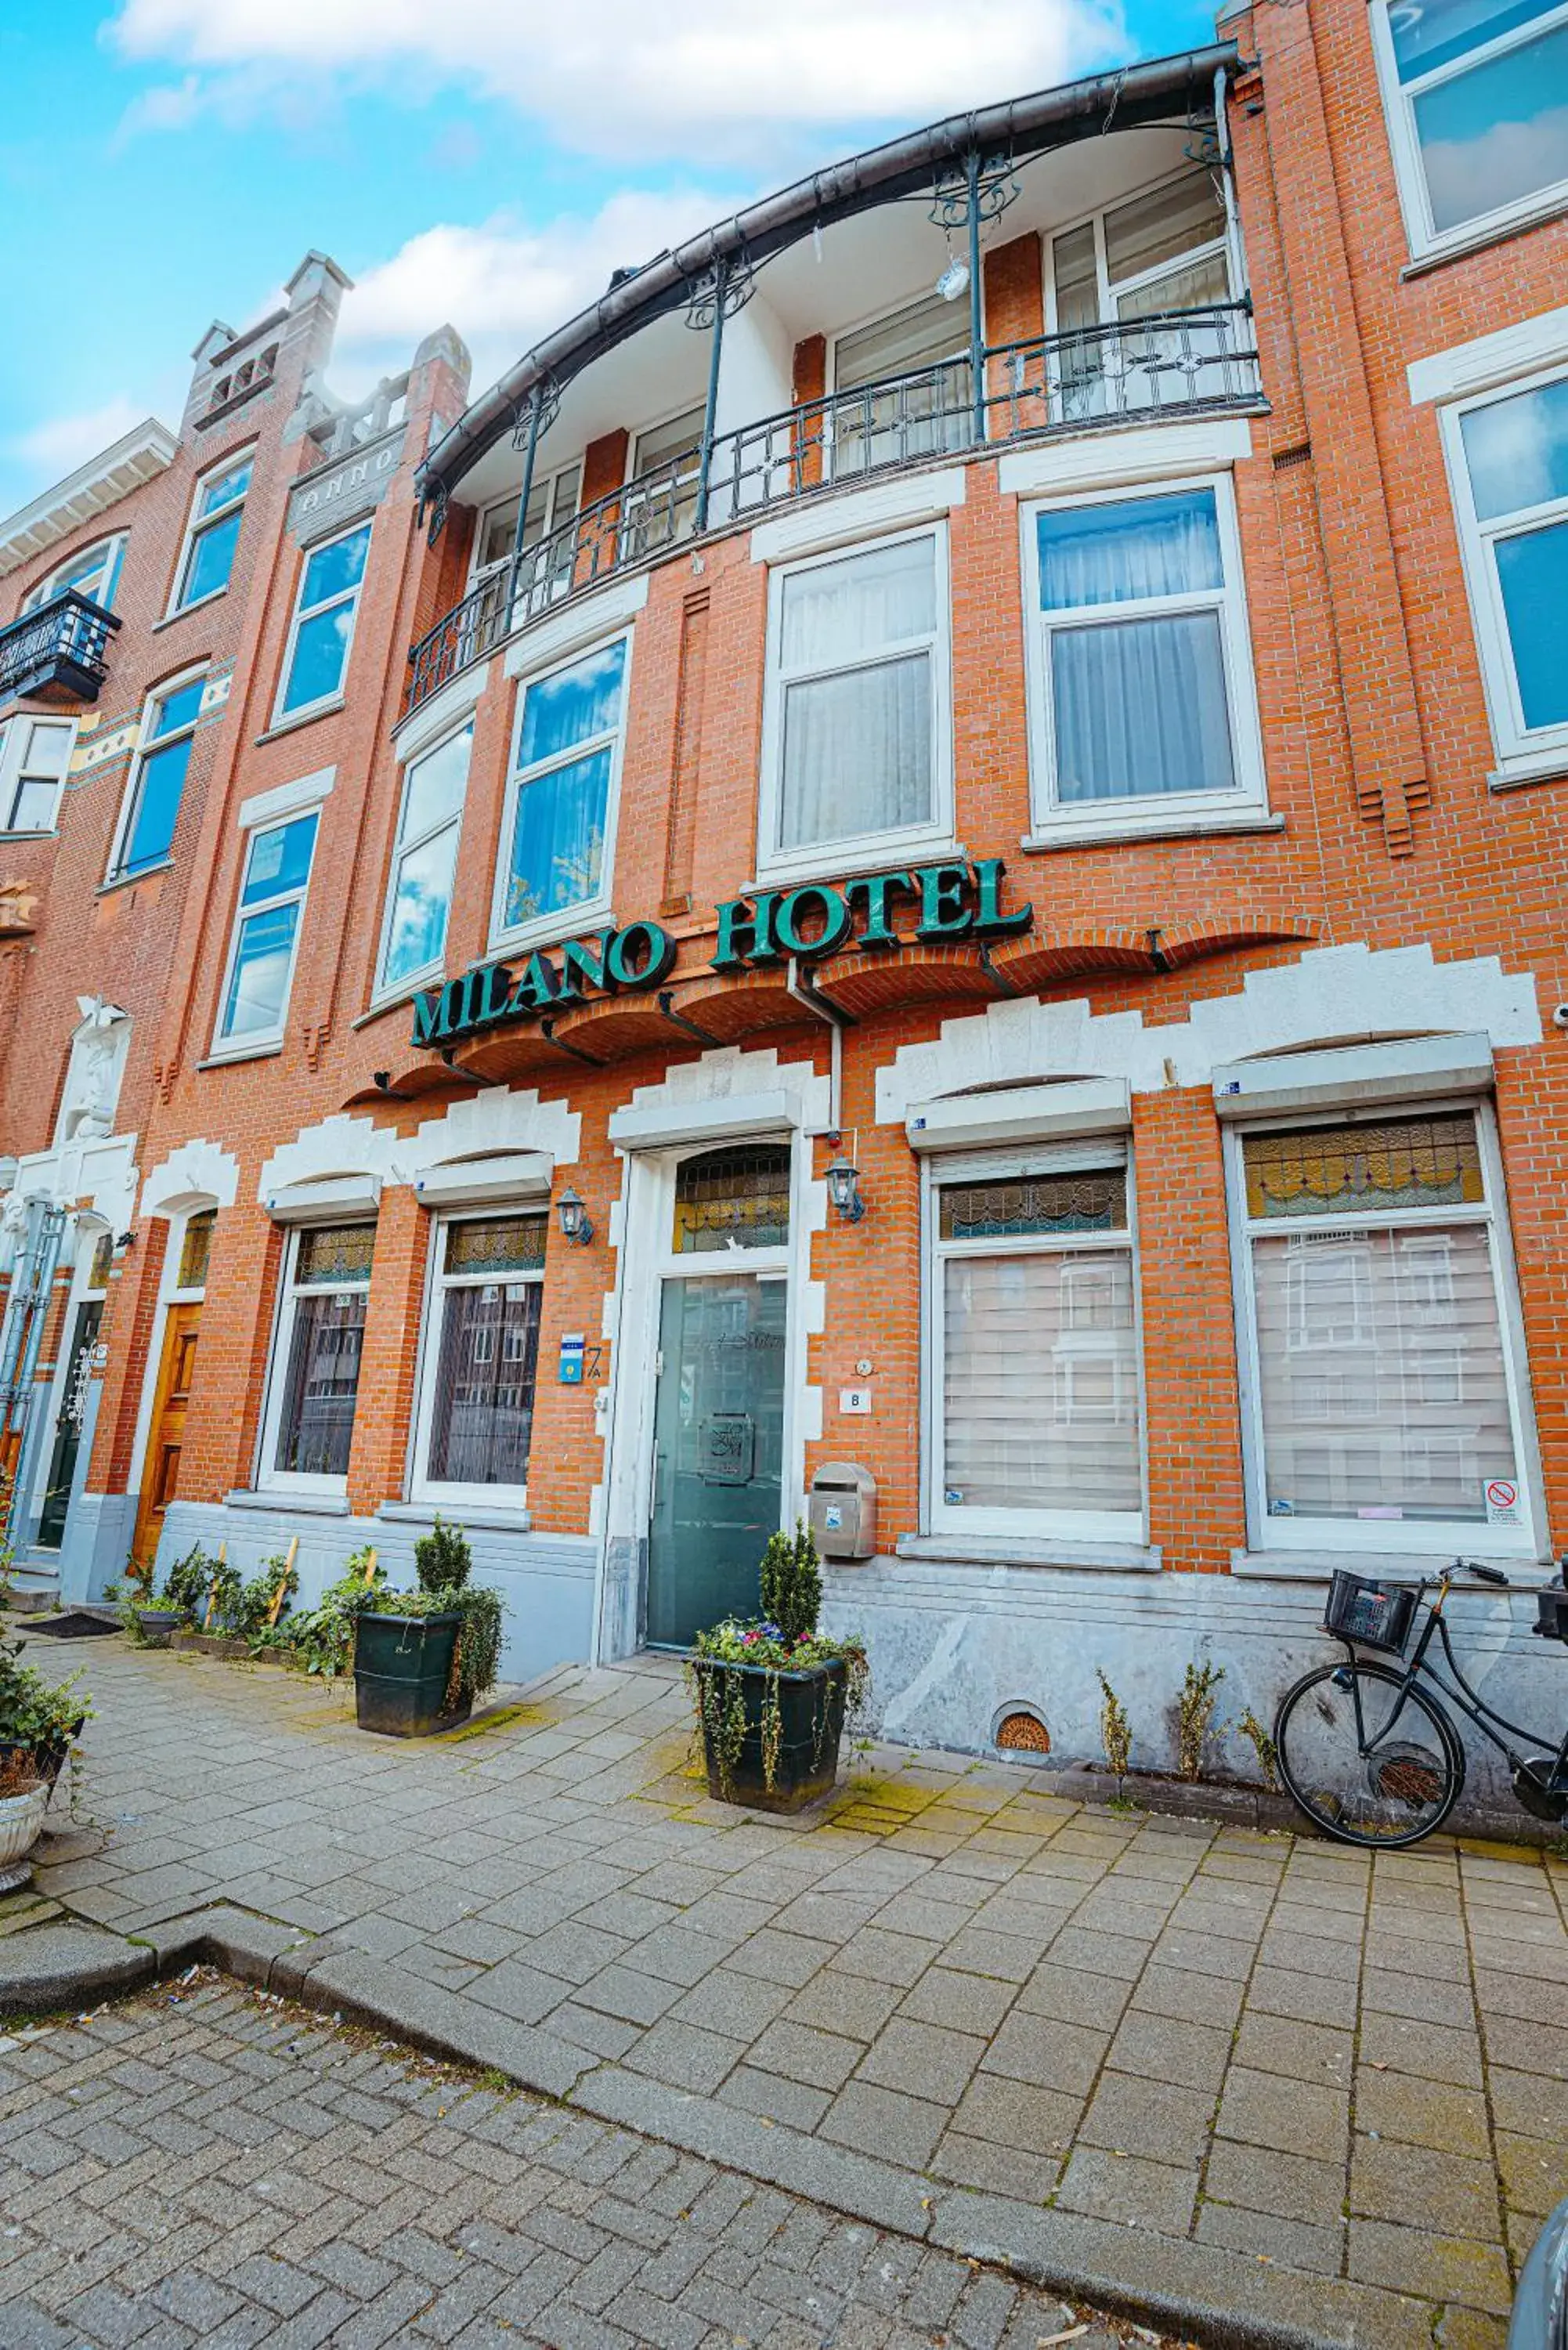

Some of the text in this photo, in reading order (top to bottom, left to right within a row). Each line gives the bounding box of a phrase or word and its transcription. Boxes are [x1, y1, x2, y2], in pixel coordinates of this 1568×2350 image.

[302, 449, 392, 512] ANNO
[410, 858, 1033, 1047] MILANO HOTEL
